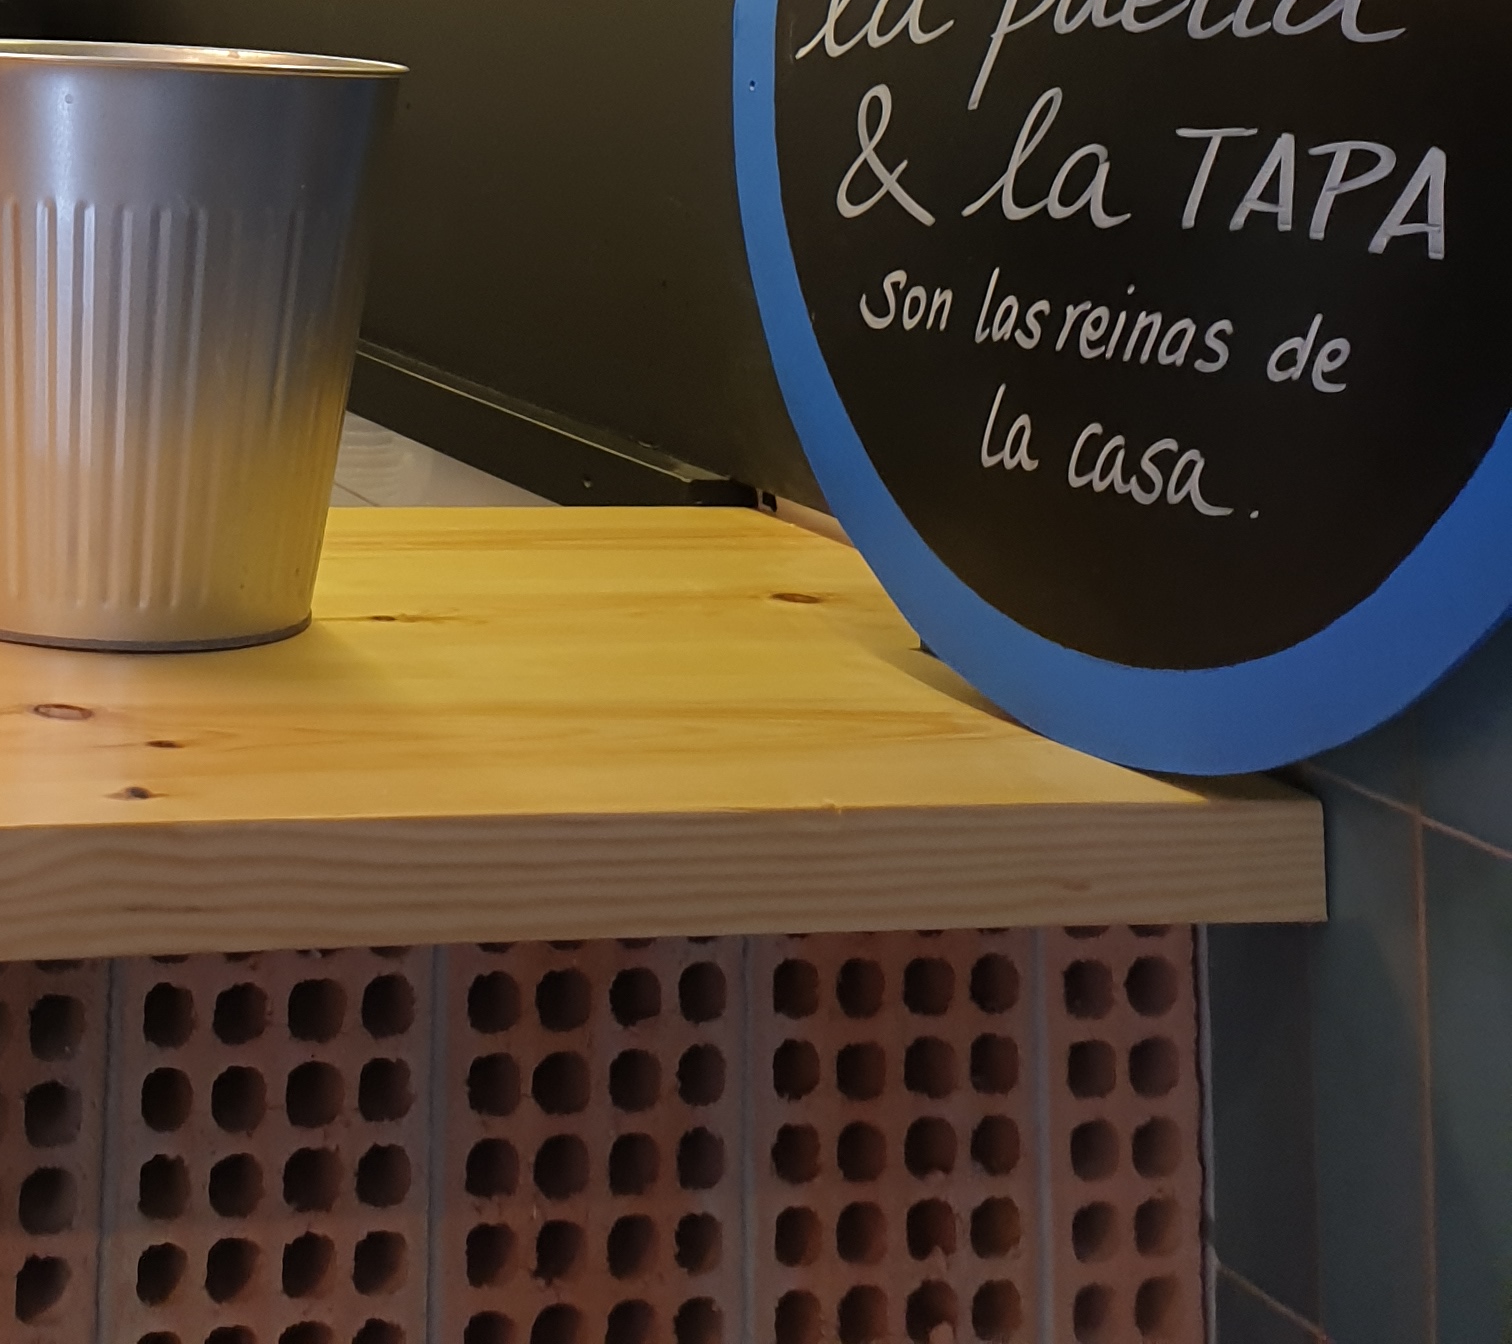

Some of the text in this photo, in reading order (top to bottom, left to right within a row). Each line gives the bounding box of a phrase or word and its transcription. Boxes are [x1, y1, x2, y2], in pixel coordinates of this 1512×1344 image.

[837, 84, 1446, 260] & la TAPA
[975, 267, 1049, 349] las
[1059, 284, 1234, 373] reinas
[1267, 314, 1350, 392] de
